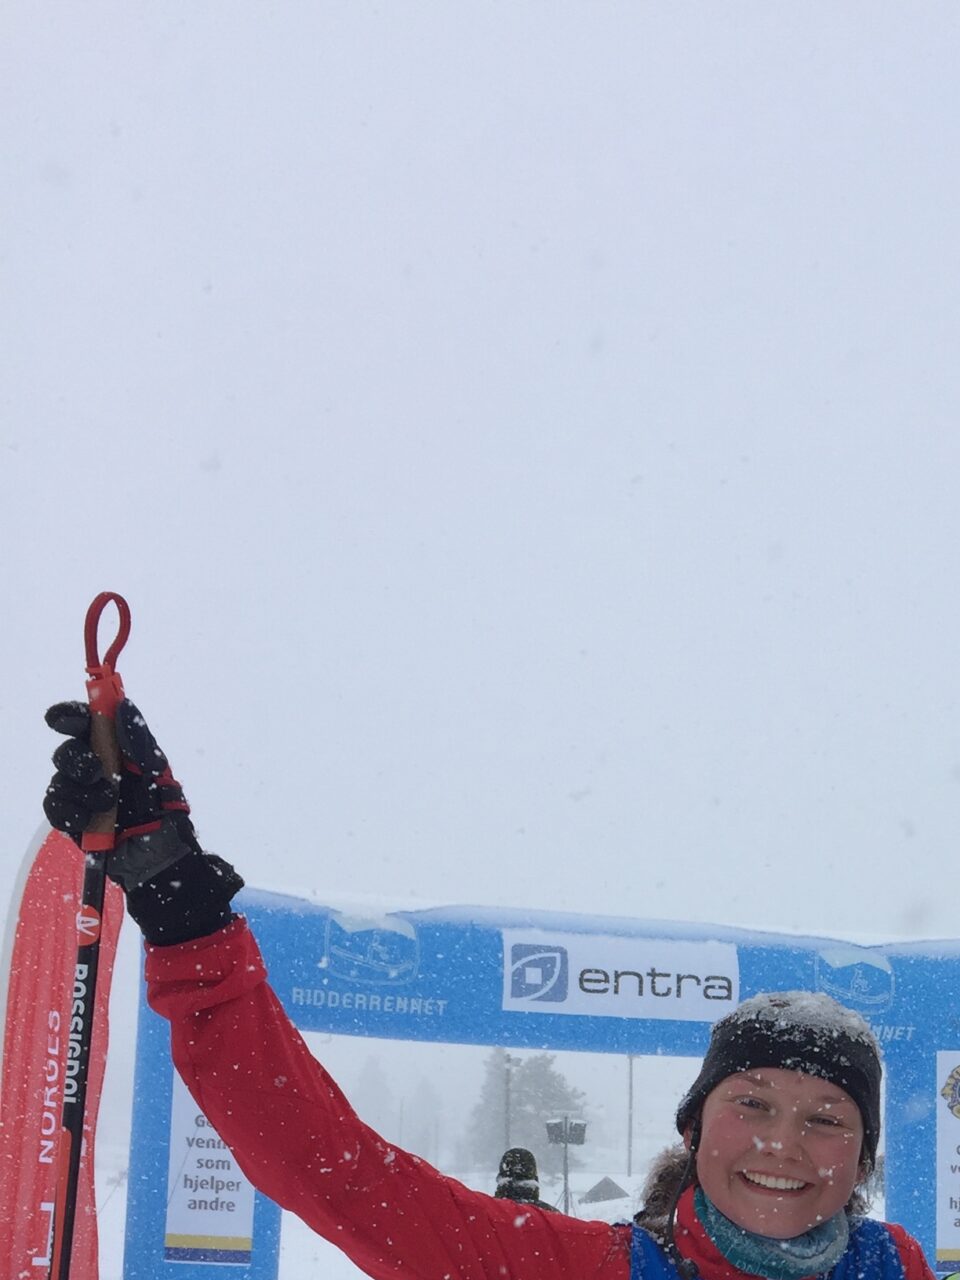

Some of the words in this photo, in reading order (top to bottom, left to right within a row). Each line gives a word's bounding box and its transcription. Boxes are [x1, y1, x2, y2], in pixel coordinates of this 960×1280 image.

[579, 966, 734, 1001] entra
[292, 986, 448, 1016] RIDDERRENNET
[186, 1136, 227, 1149] venn
[196, 1158, 231, 1170] som
[183, 1174, 242, 1194] hjelper
[187, 1198, 236, 1212] andre
